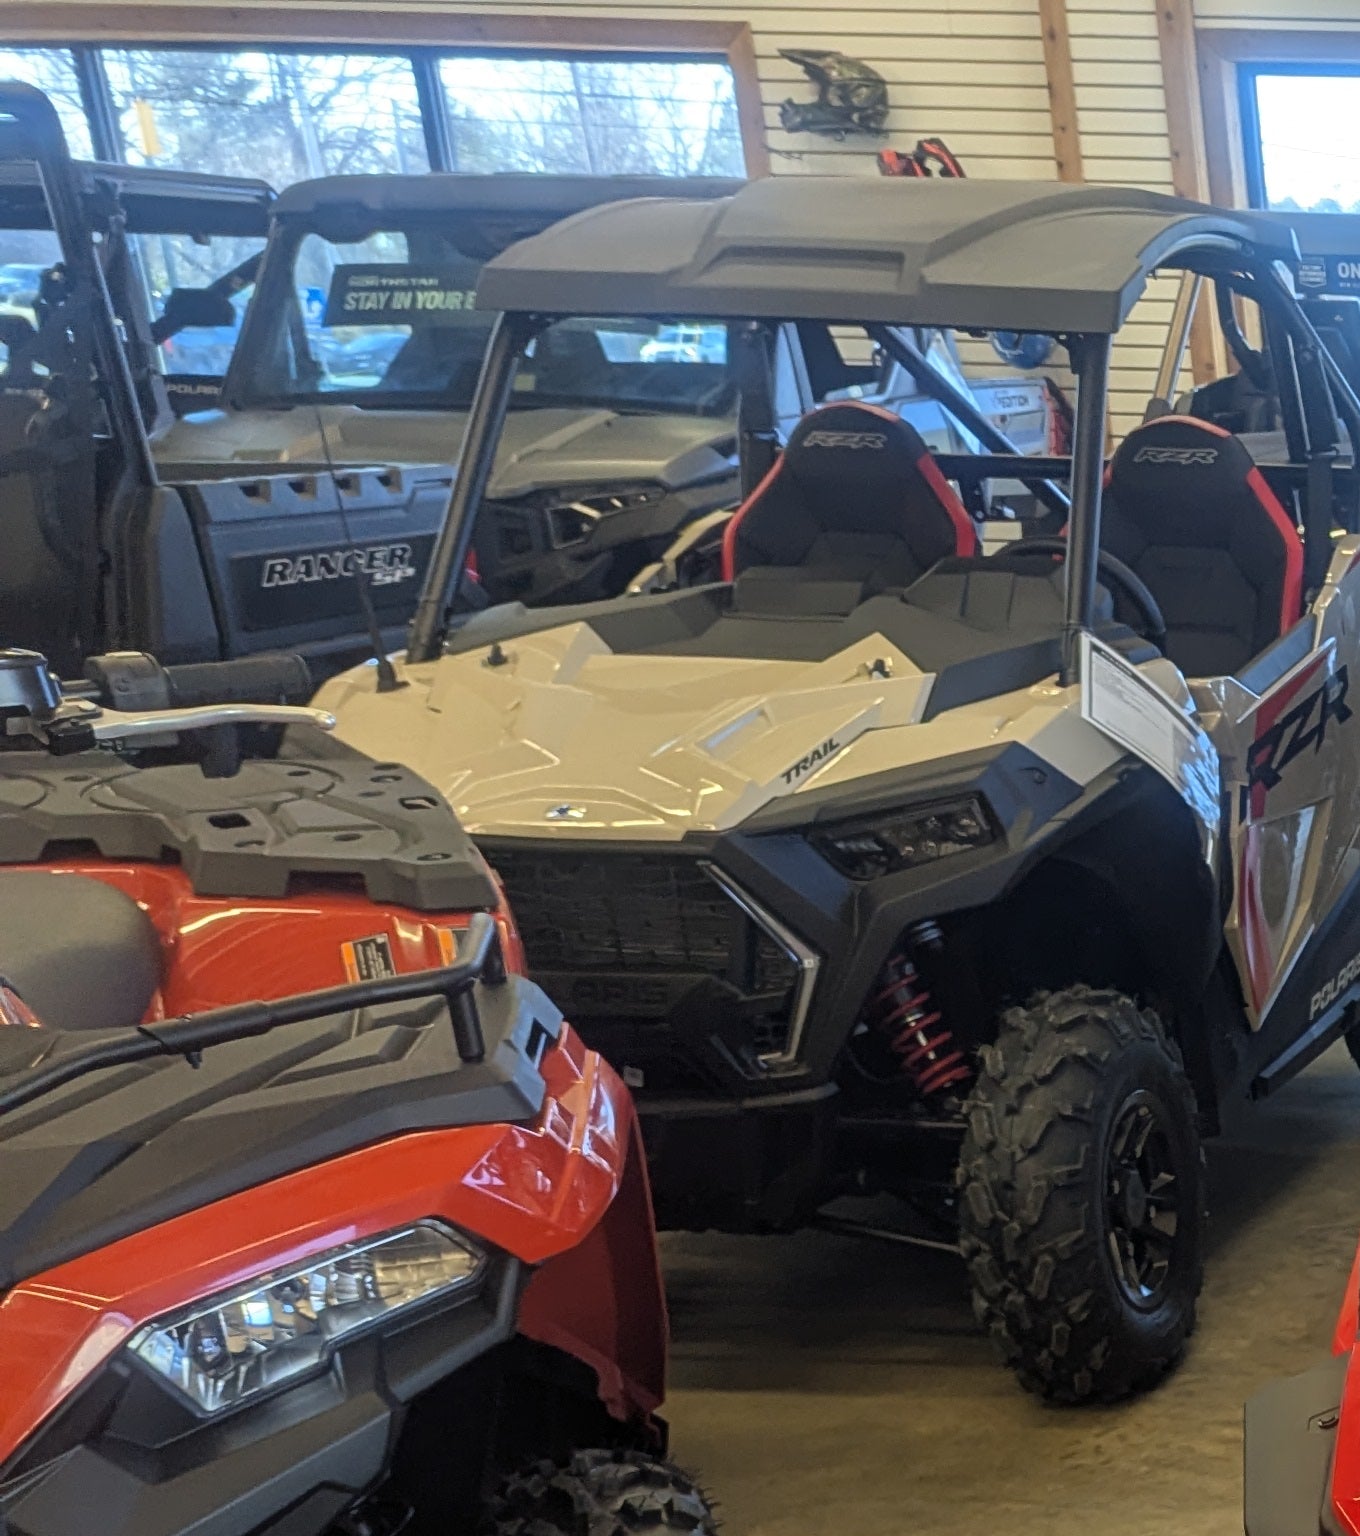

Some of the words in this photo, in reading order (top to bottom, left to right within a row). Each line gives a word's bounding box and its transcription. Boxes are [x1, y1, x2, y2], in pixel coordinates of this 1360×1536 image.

[344, 290, 390, 310] STAY
[415, 290, 463, 310] YOUR
[261, 543, 412, 587] RANGER
[1246, 664, 1353, 791] RZR
[780, 738, 840, 784] TRAIL
